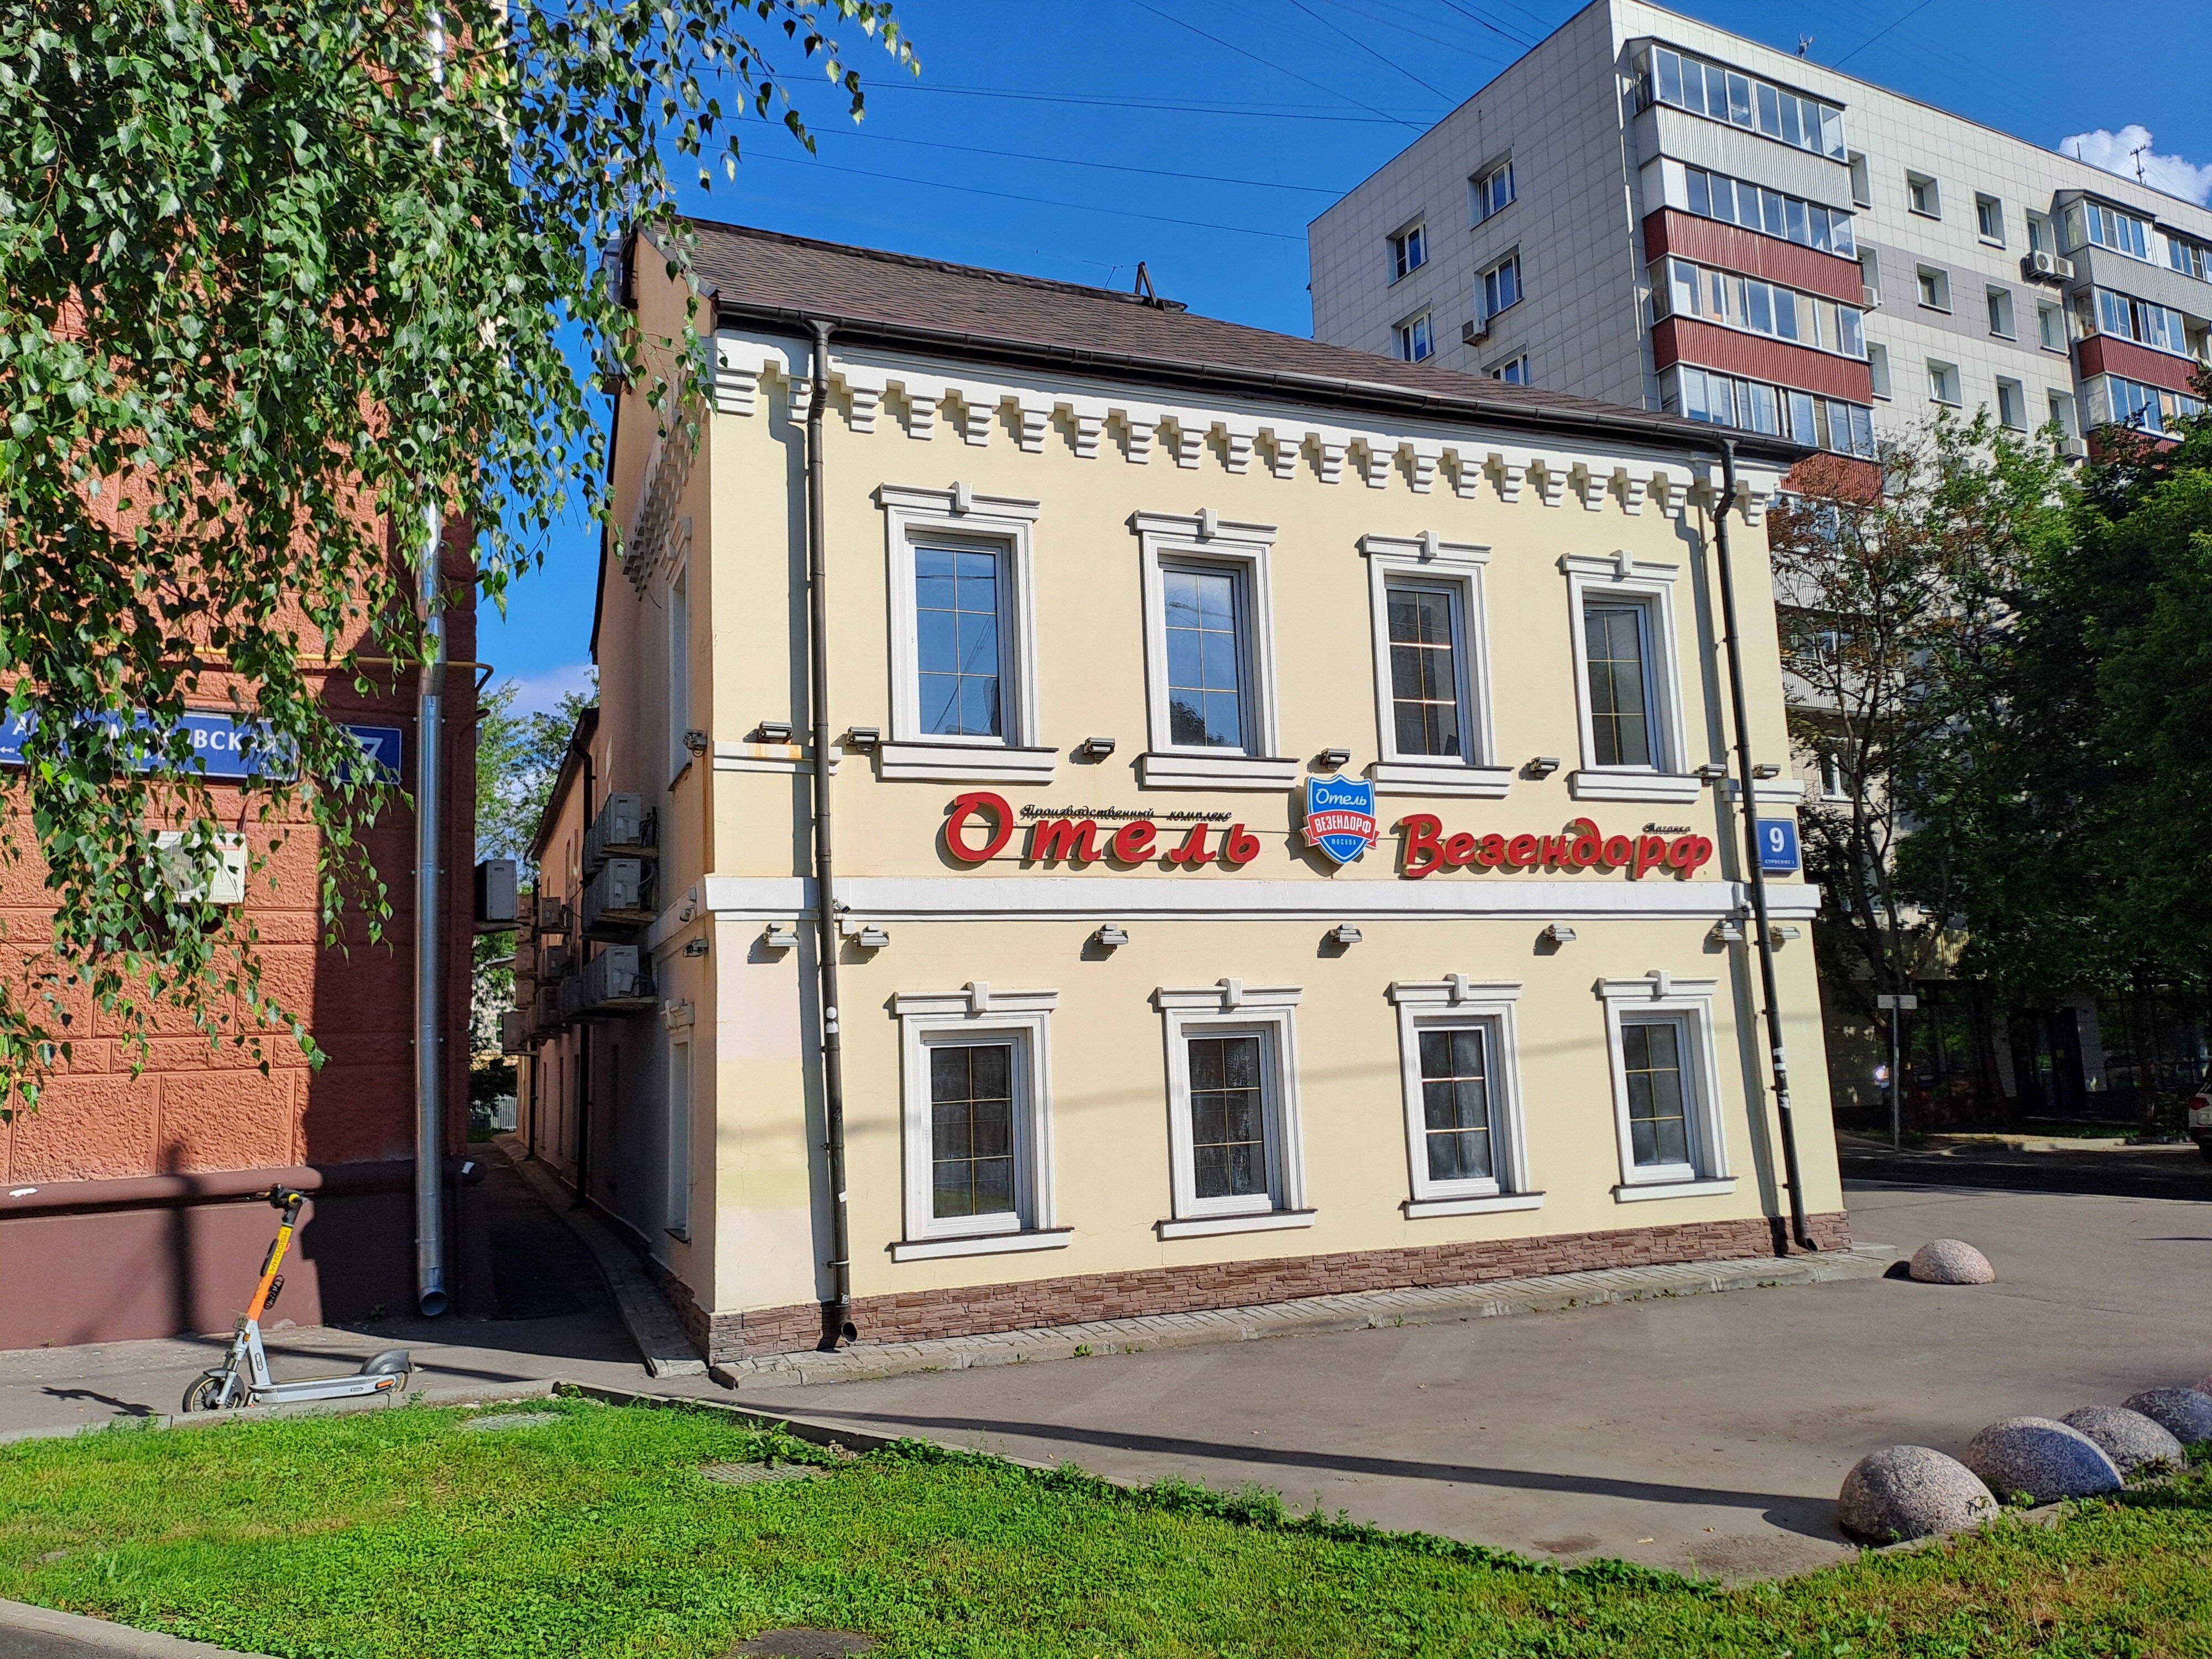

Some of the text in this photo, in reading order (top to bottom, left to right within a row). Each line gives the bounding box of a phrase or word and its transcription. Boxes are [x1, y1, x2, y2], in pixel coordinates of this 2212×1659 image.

[352, 732, 384, 762] 7
[1315, 788, 1367, 806] Отель
[1019, 804, 1233, 820] Производственный комплекс
[1314, 815, 1371, 834] ВЕЗЕНДОРФ
[946, 791, 1713, 880] Отель Везендорф
[1770, 827, 1785, 852] 9
[269, 1230, 289, 1272] WHOOSH
